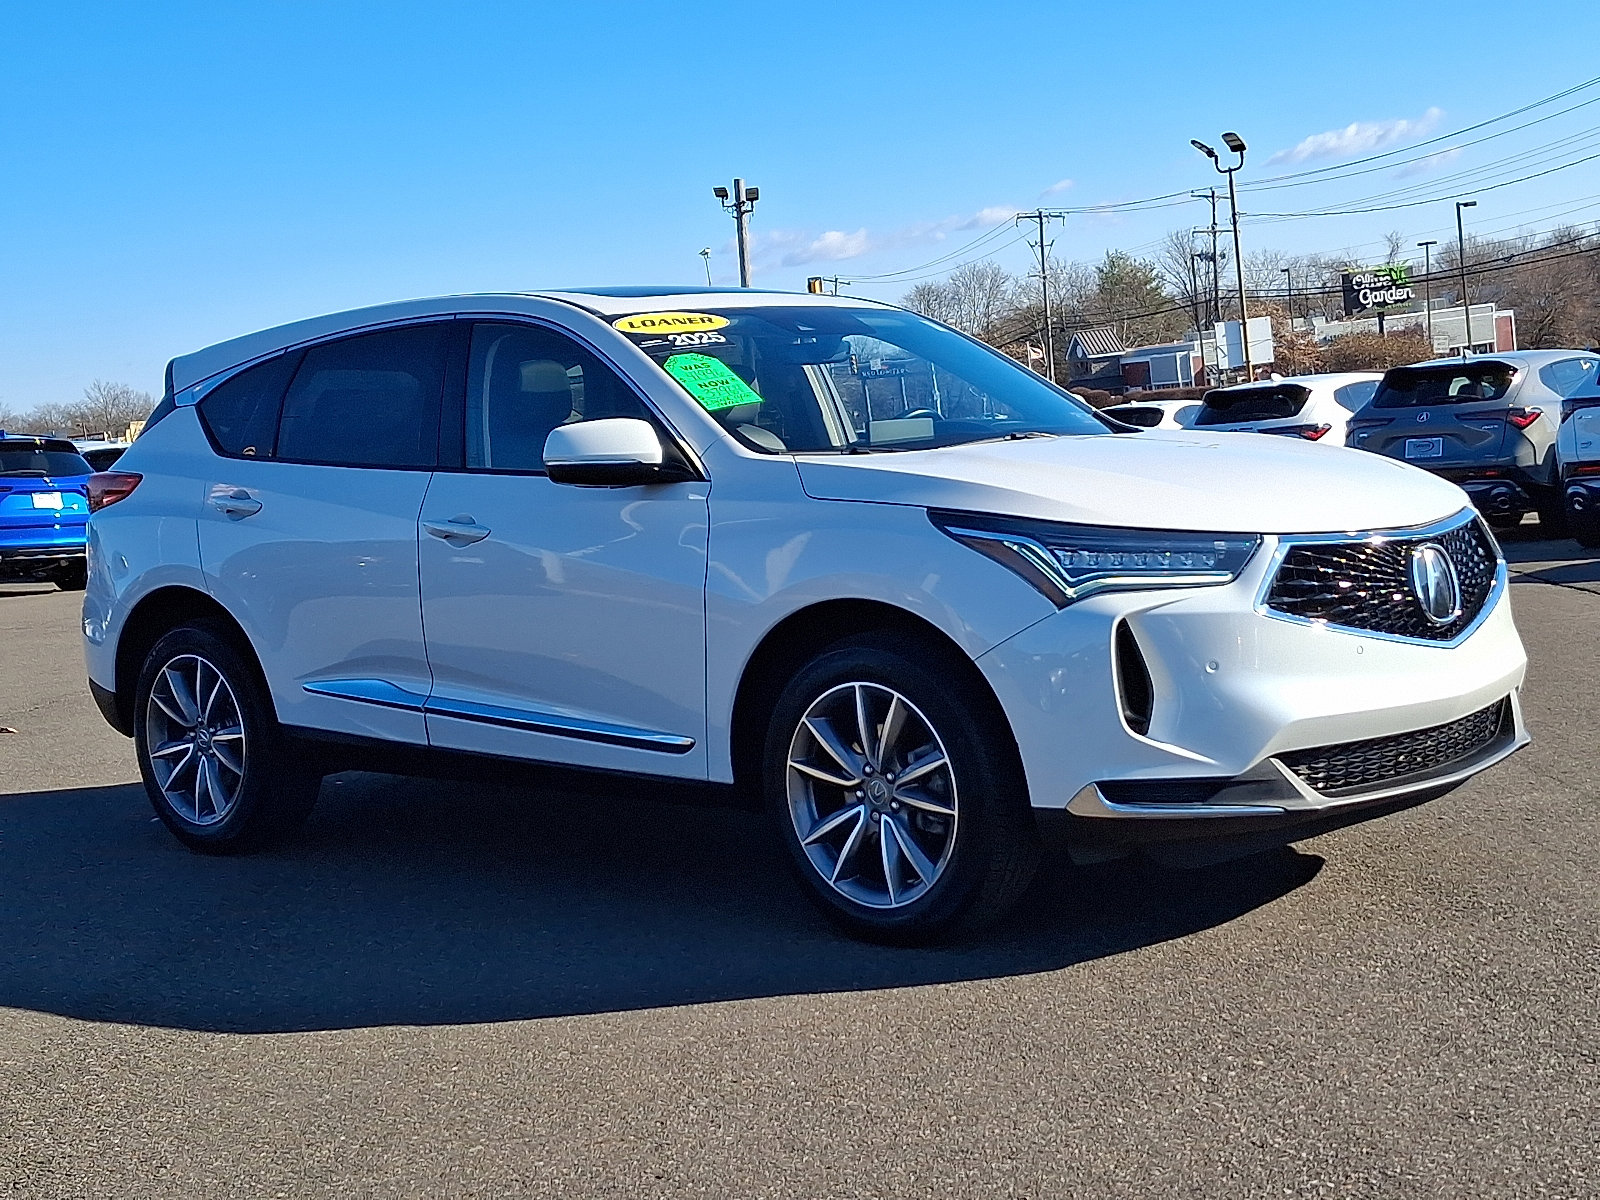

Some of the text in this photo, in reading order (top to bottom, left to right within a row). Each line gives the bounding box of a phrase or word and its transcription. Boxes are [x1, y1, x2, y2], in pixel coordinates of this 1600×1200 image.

[1352, 273, 1392, 289] Olive
[1359, 286, 1415, 308] Garden
[628, 316, 715, 329] LOANER
[667, 332, 727, 346] 2025
[679, 362, 711, 371] WAS
[697, 379, 730, 388] NOW
